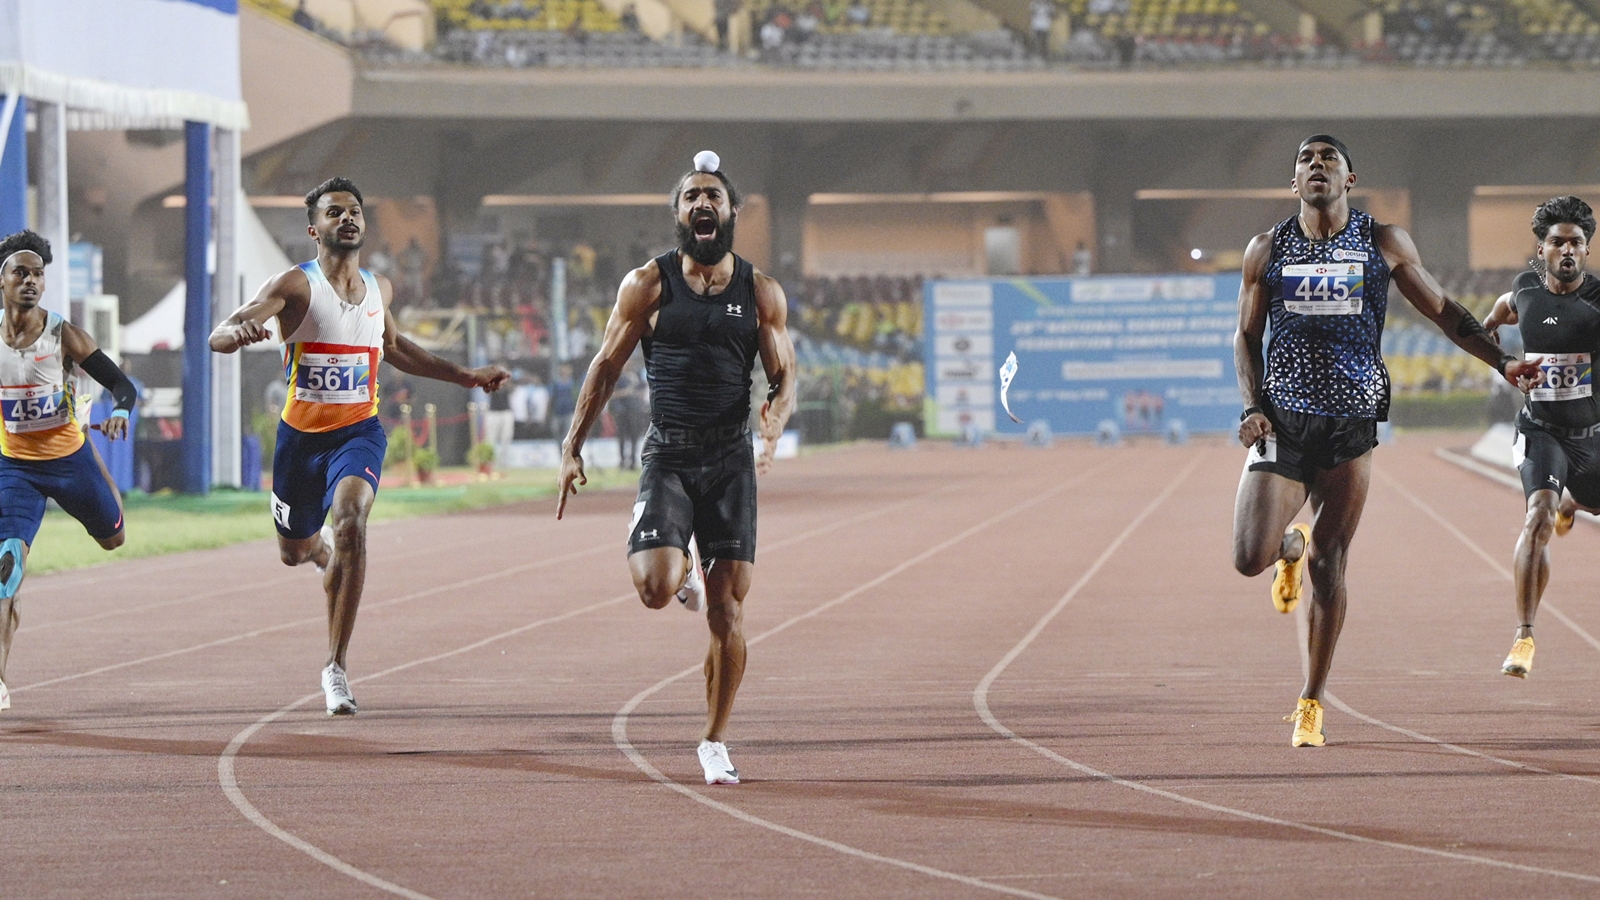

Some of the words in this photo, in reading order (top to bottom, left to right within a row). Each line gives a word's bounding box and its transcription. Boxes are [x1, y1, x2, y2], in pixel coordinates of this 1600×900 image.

[1294, 276, 1350, 301] 445
[307, 366, 355, 391] 561
[1537, 366, 1579, 389] 68
[11, 395, 57, 421] 454
[276, 503, 283, 522] 5
